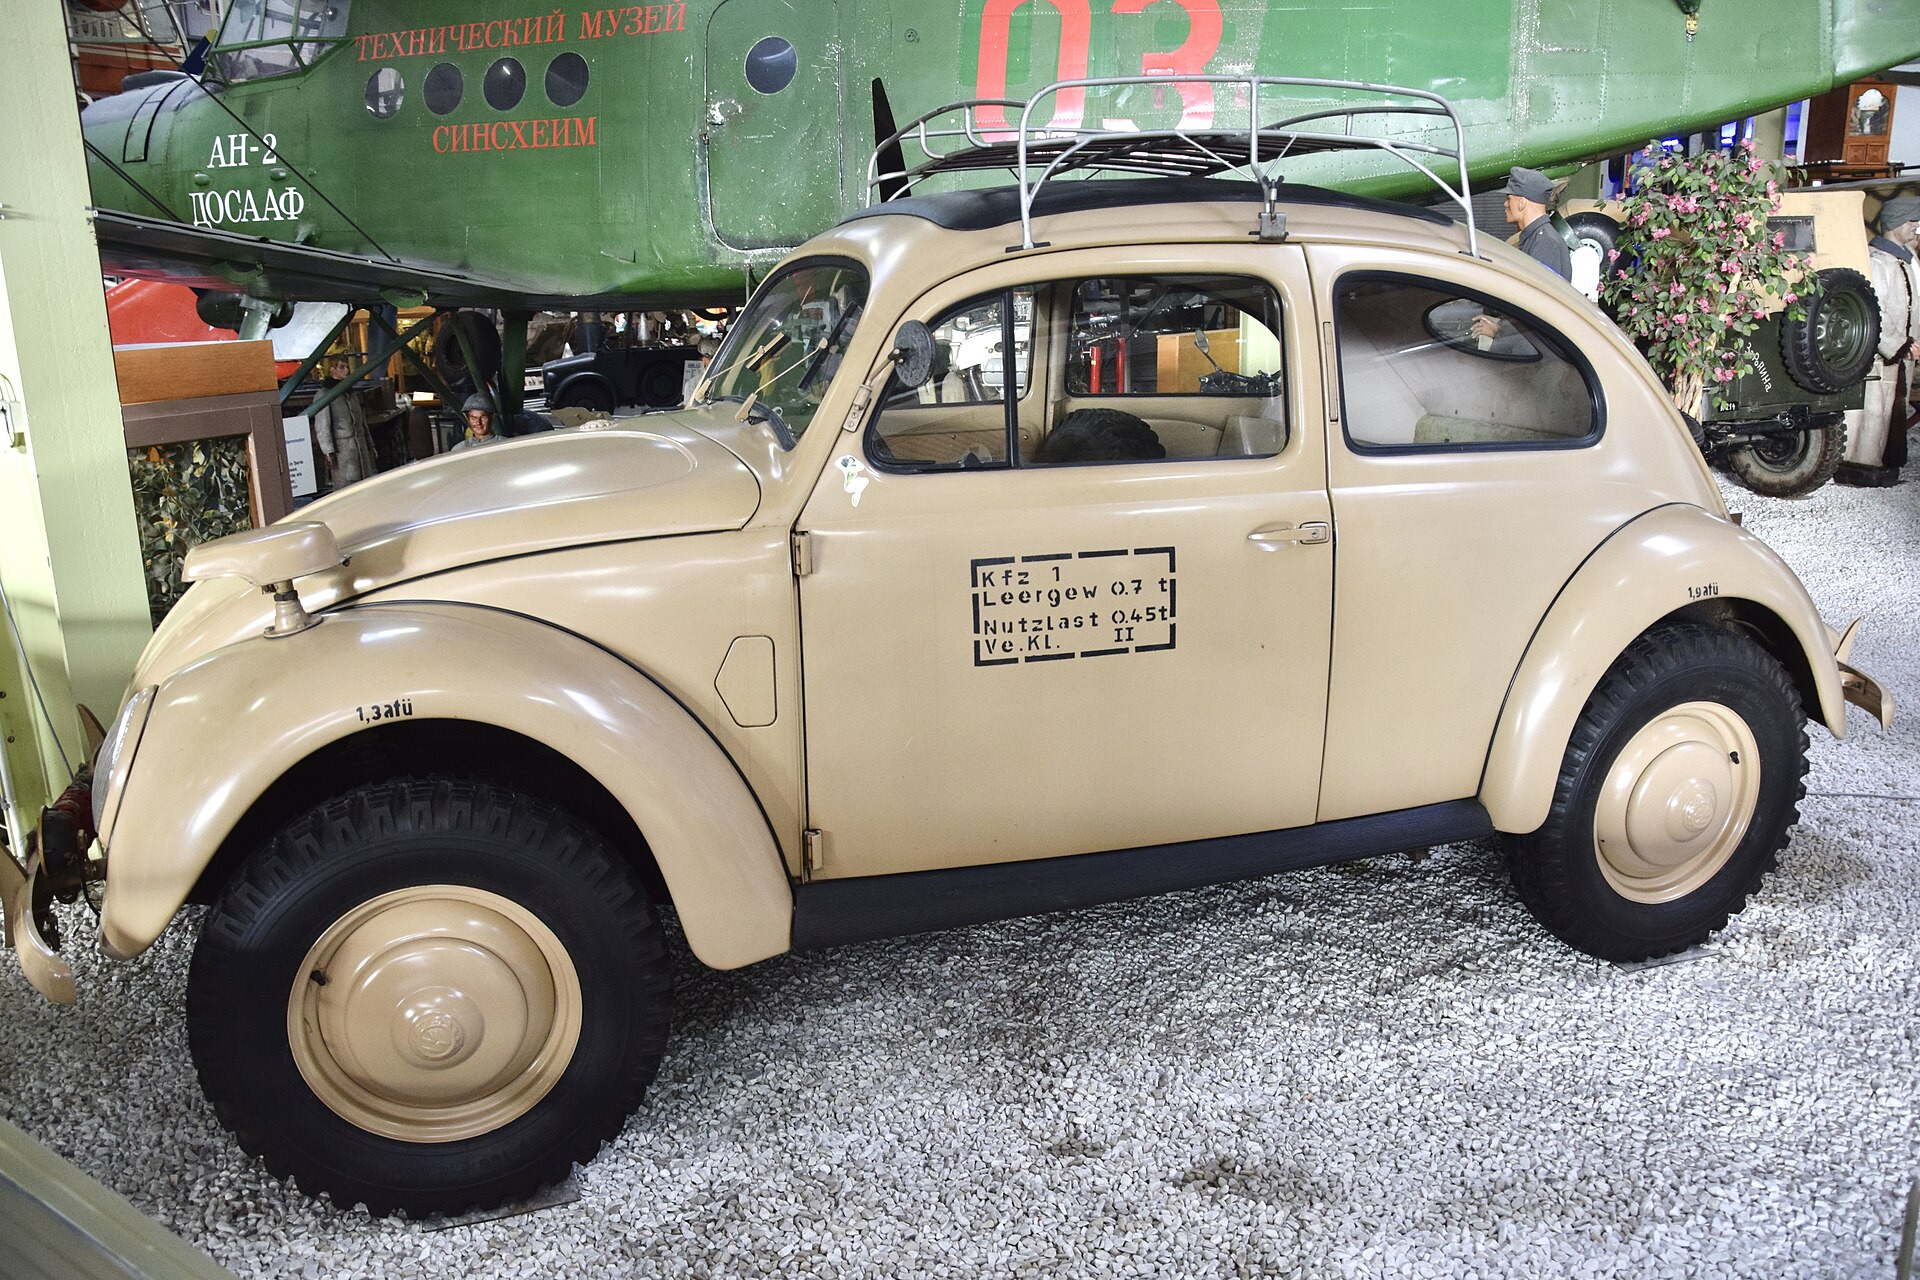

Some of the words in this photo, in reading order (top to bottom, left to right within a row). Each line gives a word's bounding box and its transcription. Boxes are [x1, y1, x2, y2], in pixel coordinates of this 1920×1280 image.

[354, 8, 566, 62] ТЕХНИЧЕСКИЙ
[578, 0, 687, 40] МУЗЕЙ
[974, 0, 1223, 143] 03
[206, 133, 277, 168] АН-2
[432, 116, 598, 154] СИНСХЕИМ
[188, 186, 304, 229] ДОСААФ
[982, 570, 1029, 587] Kfz
[1052, 566, 1060, 582] 1
[983, 585, 1097, 607] Leergew
[1111, 579, 1143, 596] 0.7
[1158, 577, 1168, 592] t
[984, 611, 1099, 635] Nutzlast
[1114, 627, 1135, 642] II
